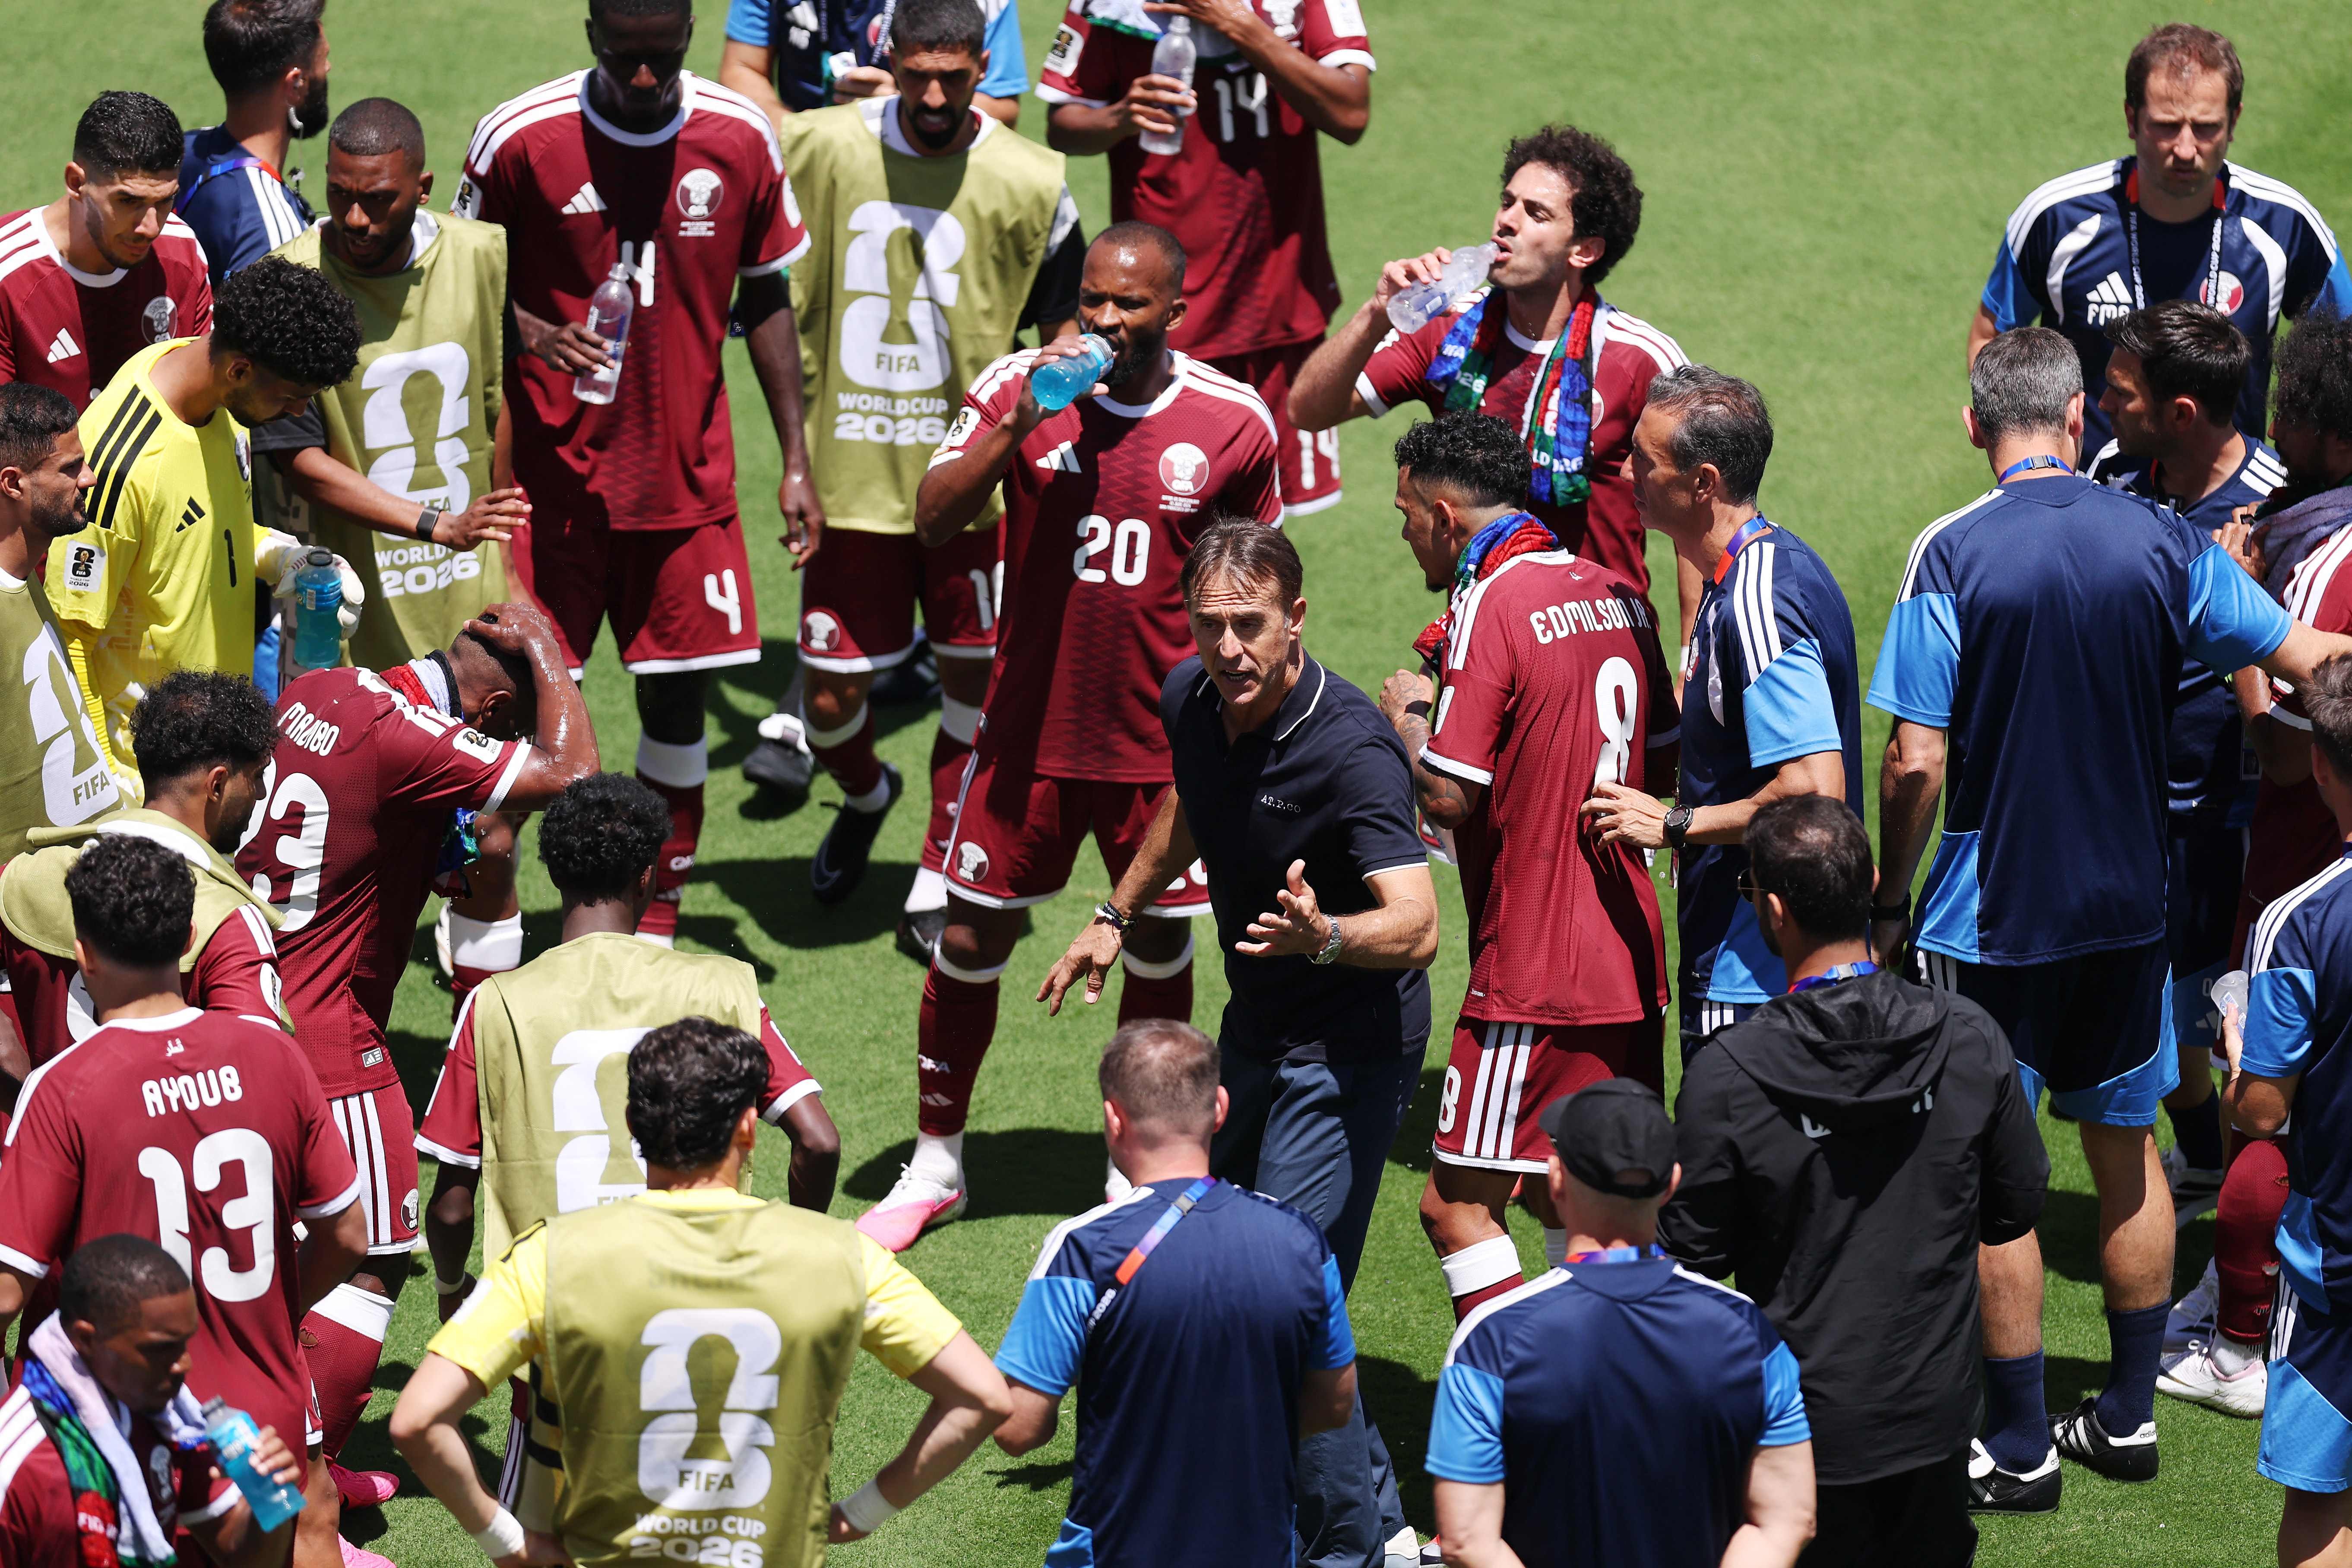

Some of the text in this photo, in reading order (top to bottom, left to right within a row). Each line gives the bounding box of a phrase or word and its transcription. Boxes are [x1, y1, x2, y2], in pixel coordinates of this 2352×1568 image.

[1214, 72, 1269, 143] 14
[622, 241, 655, 307] 4
[2135, 285, 2146, 310] 202
[876, 352, 920, 372] FIFA
[837, 392, 949, 416] WORLD CUP
[834, 412, 947, 446] 2026
[374, 543, 447, 568] WORLD
[1074, 514, 1151, 586] 20
[380, 551, 481, 599] 2026
[704, 569, 742, 635] 4
[1529, 597, 1635, 645] EDMILSON
[1594, 656, 1638, 816] 8
[73, 770, 111, 807] FIFA
[142, 1065, 243, 1118] AYOUB
[1438, 1065, 1462, 1134] 8
[137, 1128, 275, 1302] 13
[679, 1470, 734, 1492] FIFA
[636, 1513, 767, 1539] WORLD CUP
[630, 1535, 764, 1568] 2026
